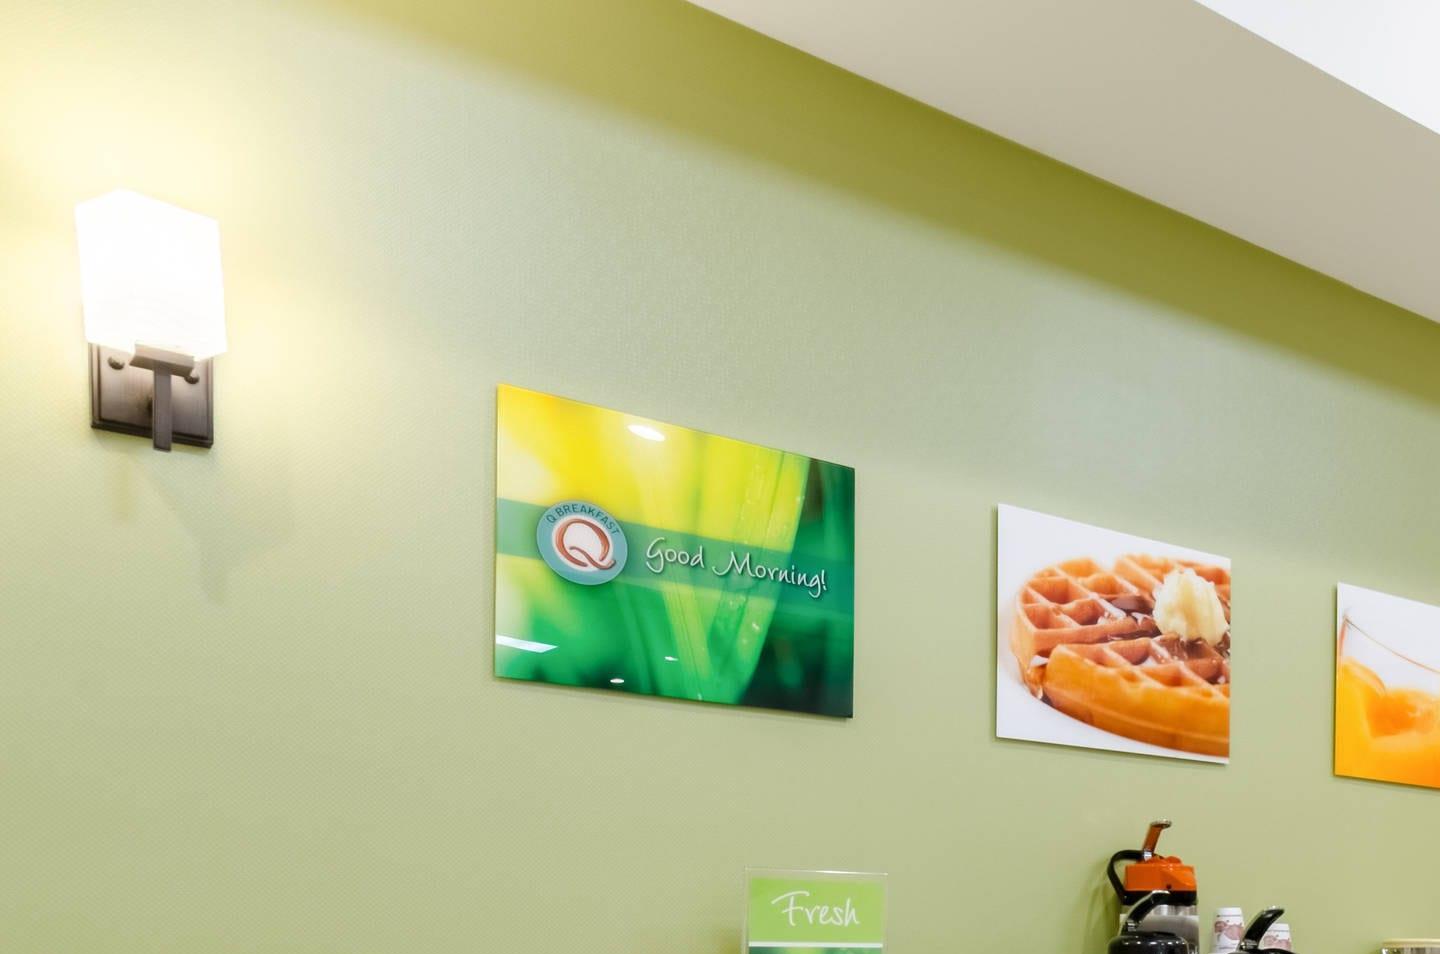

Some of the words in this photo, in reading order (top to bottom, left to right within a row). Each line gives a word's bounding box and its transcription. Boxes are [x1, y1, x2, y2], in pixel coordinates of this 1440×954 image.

[546, 514, 557, 524] Q
[555, 503, 620, 535] BREAKFAST
[555, 518, 617, 571] Q
[645, 536, 705, 573] Good
[711, 551, 828, 599] Morning!
[771, 890, 861, 927] Fresh
